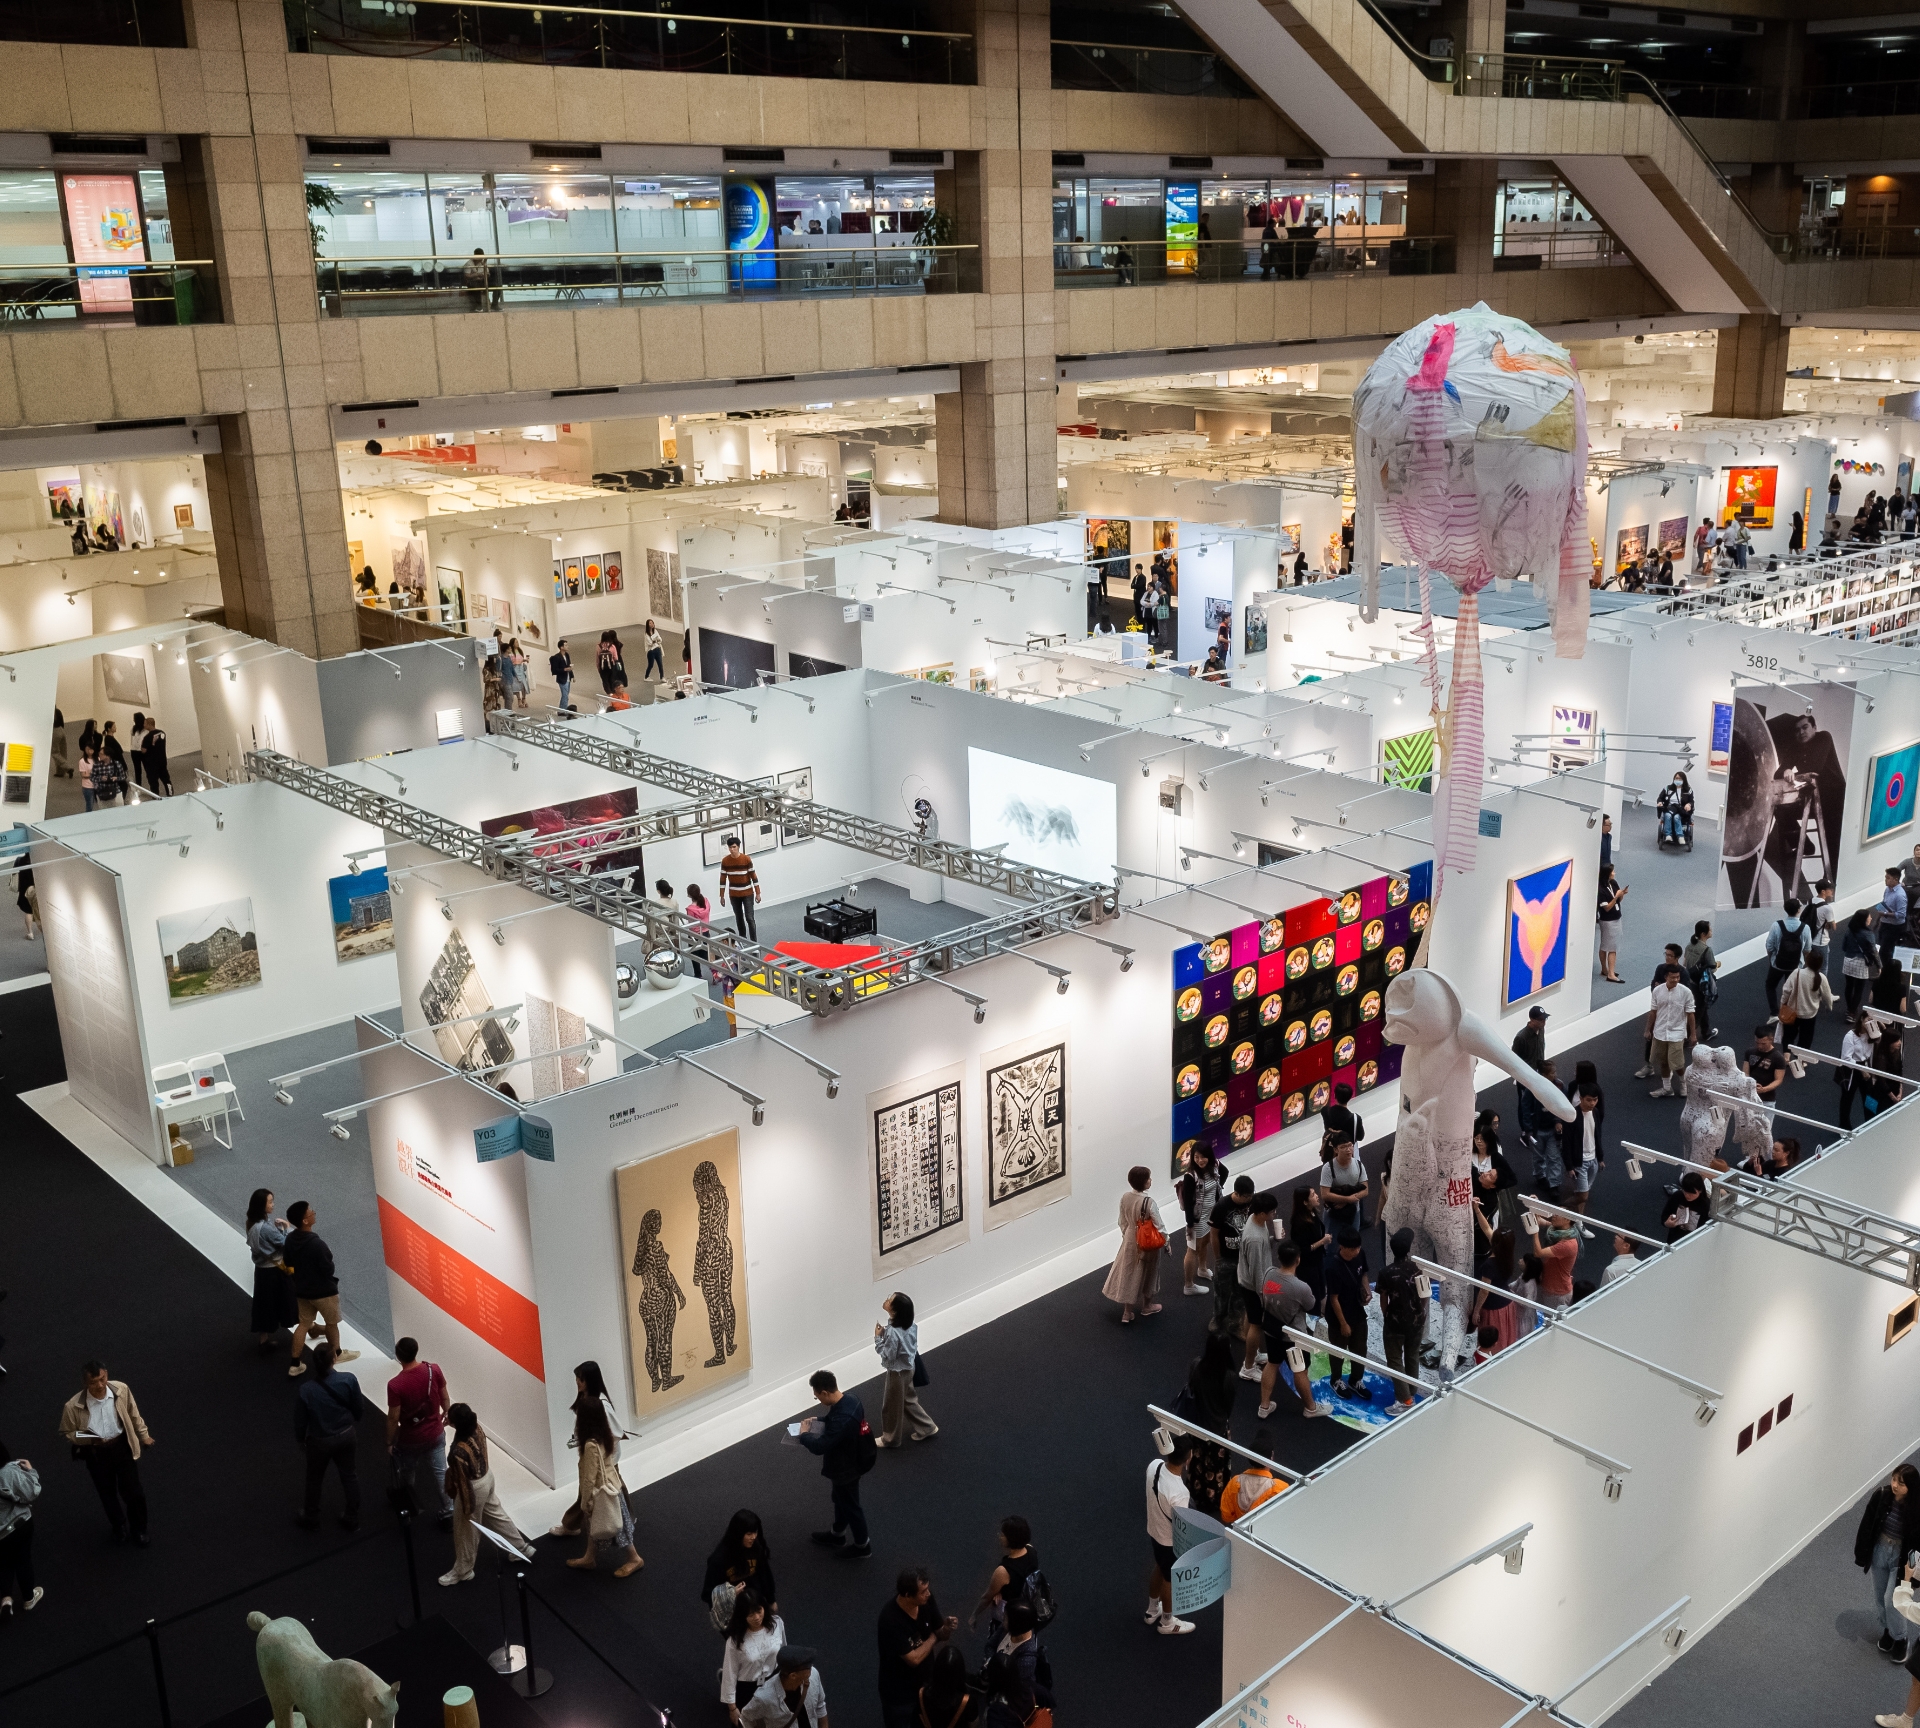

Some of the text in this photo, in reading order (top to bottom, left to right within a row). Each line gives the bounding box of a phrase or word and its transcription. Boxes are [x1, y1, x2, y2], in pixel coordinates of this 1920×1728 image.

[1746, 654, 1778, 671] 3812
[1488, 814, 1500, 822] Y03
[609, 1102, 679, 1129] Gender Deconstruction
[477, 1129, 496, 1140] Y03
[533, 1127, 550, 1139] Y03
[1173, 1513, 1187, 1535] Y02
[1175, 1566, 1200, 1583] Y02
